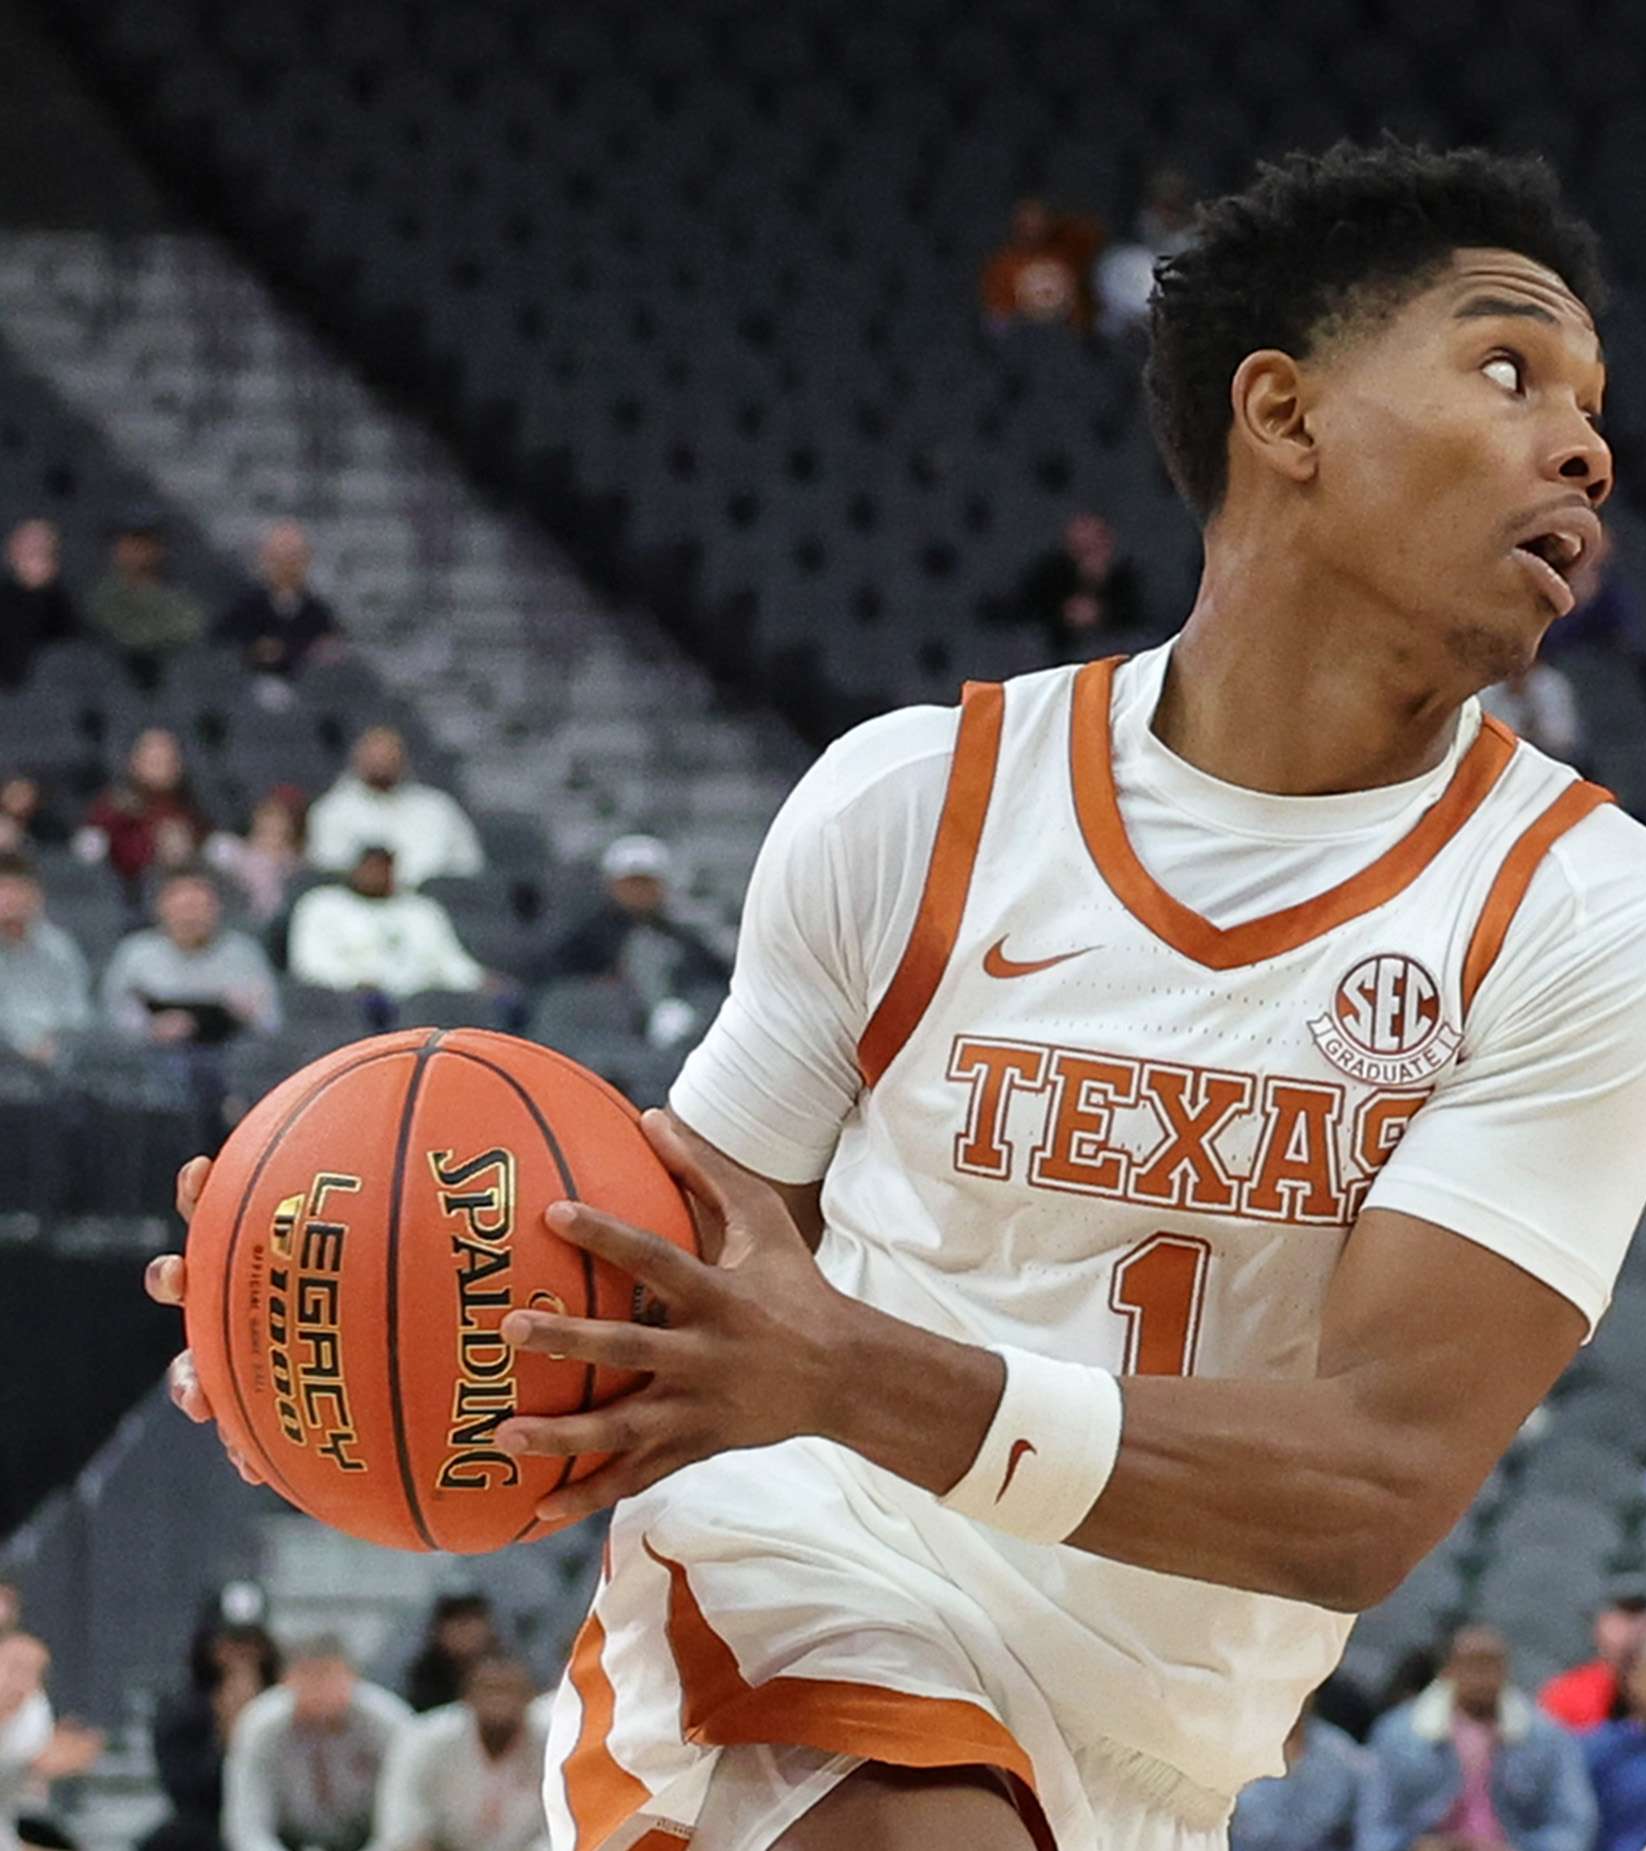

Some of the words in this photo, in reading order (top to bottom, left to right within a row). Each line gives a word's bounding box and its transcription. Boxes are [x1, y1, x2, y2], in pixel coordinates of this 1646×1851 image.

[1324, 1038, 1443, 1084] GRADUATE
[1341, 957, 1435, 1052] SEC
[268, 1268, 308, 1446] 1000
[296, 1172, 368, 1473] LEGACY
[427, 1146, 520, 1492] SPALDING
[1108, 1230, 1212, 1377] 1
